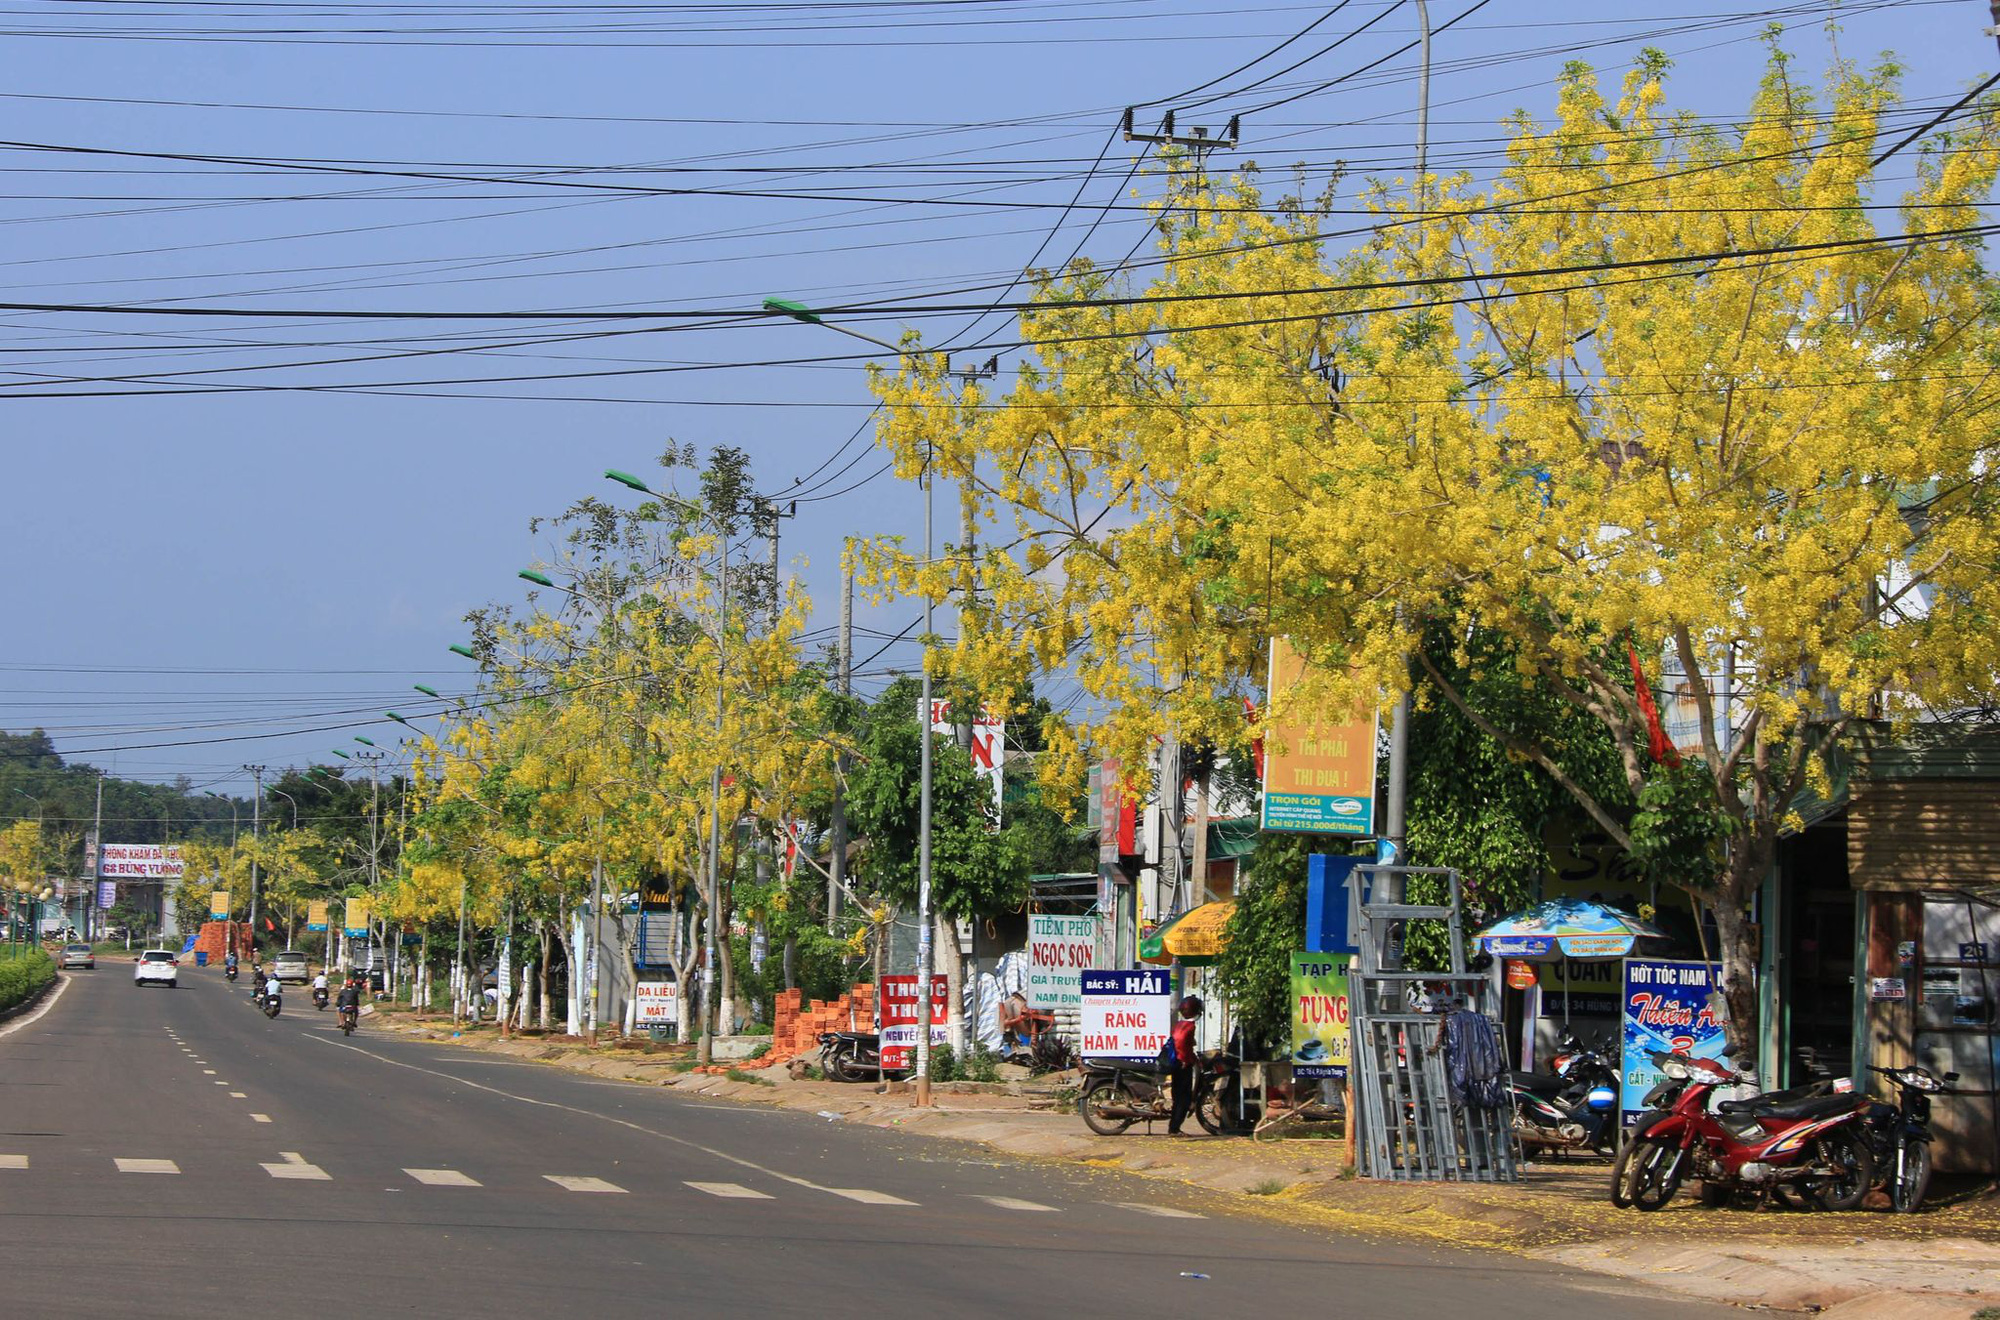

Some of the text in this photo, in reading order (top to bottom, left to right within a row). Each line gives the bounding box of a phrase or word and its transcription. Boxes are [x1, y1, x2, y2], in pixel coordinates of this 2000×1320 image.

[1320, 734, 1348, 757] PHẢI
[1294, 768, 1313, 786] THI
[1316, 770, 1340, 787] ĐUA
[1270, 795, 1321, 806] TRỌN GÓI
[102, 862, 117, 875] 68
[1033, 916, 1064, 938] TIỆM
[1032, 939, 1093, 973] NGỌC SƠN
[1964, 945, 1984, 958] 26
[1031, 975, 1048, 985] GIA
[1299, 963, 1332, 979] TẠP
[1630, 964, 1652, 983] HỚT
[1654, 965, 1677, 983] TÓC
[1679, 969, 1706, 986] NAM
[638, 987, 651, 997] DA
[1086, 979, 1104, 990] BÁC
[1125, 971, 1162, 994] HẢI
[1035, 994, 1059, 1002] NAM
[1299, 986, 1349, 1025] TÙNG
[1572, 1000, 1585, 1010] 34
[932, 1004, 944, 1018] Y
[1104, 1009, 1147, 1028] RĂNG
[1630, 992, 1692, 1026] Thiên
[1084, 1030, 1118, 1051] HÀM
[1134, 1031, 1167, 1055] MẶT
